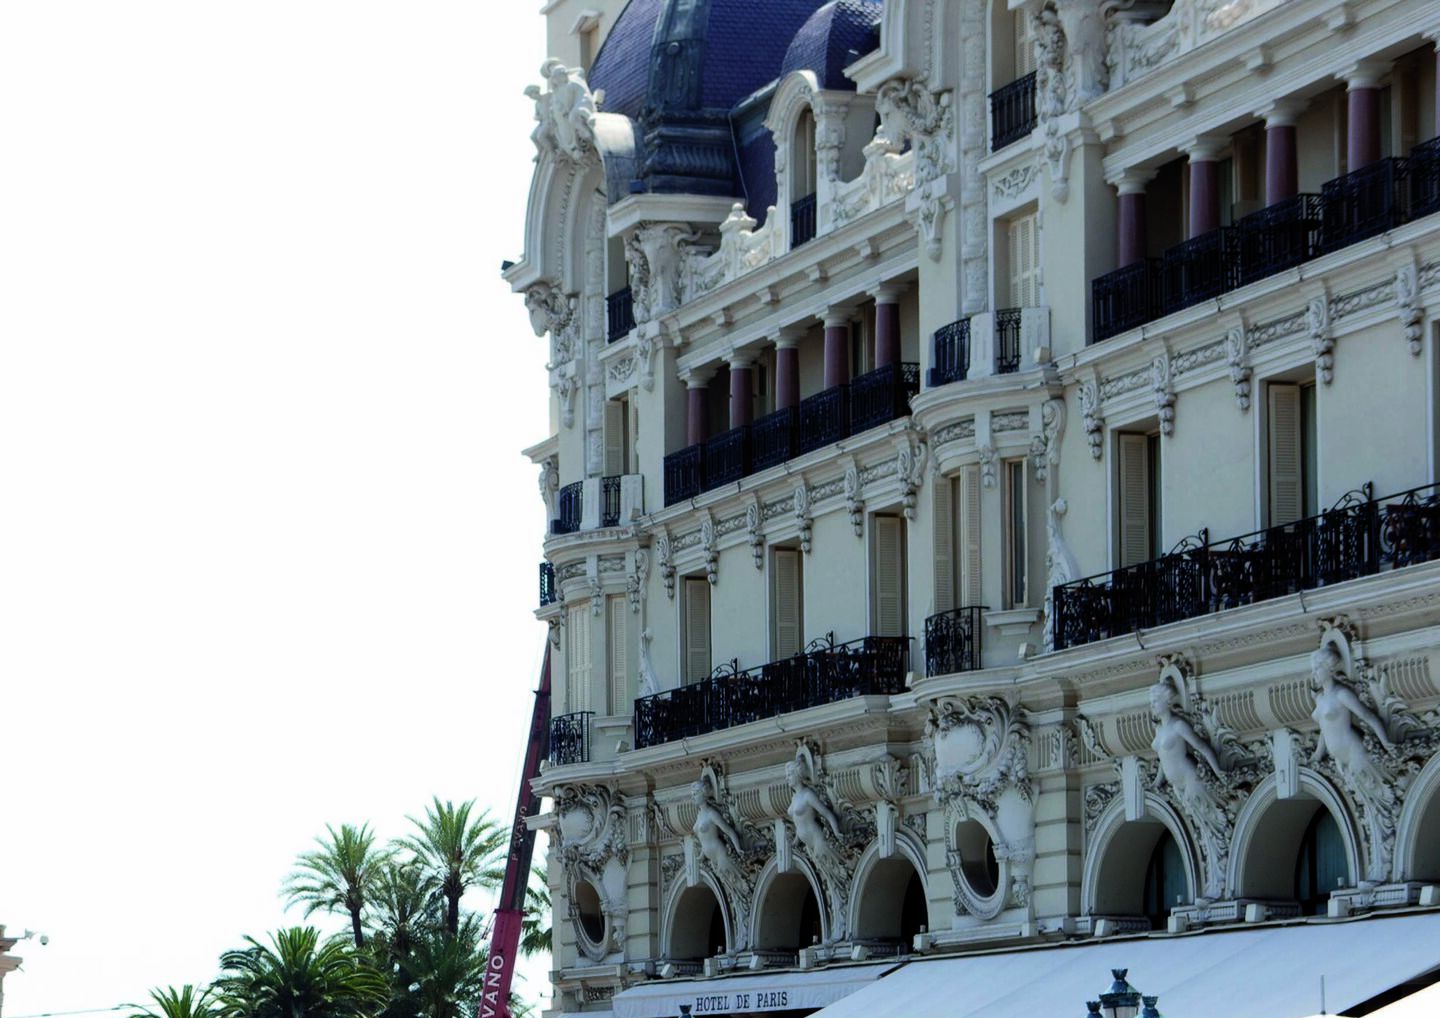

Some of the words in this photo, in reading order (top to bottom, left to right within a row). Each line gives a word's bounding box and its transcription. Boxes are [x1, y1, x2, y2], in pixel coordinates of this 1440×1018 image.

[695, 996, 730, 1012] HOTEL
[737, 994, 750, 1009] DE
[757, 991, 788, 1008] PARIS
